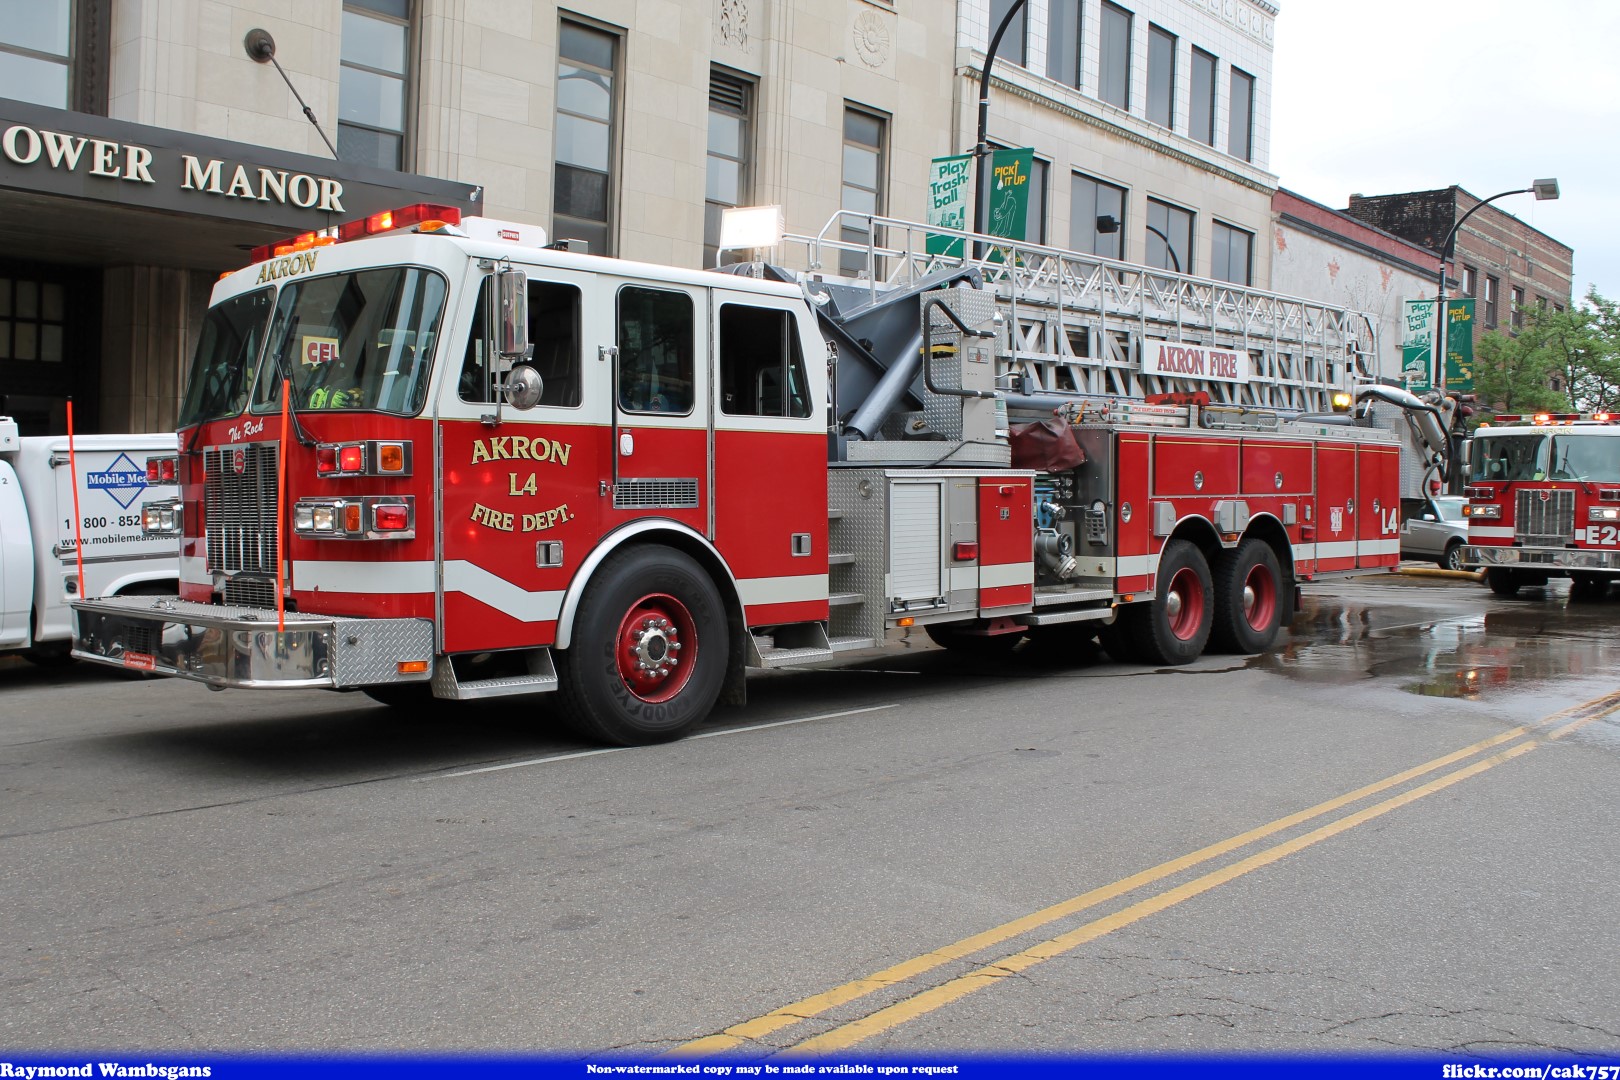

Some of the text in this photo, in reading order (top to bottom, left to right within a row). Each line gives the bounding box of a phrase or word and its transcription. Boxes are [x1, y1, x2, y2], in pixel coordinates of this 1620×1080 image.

[938, 160, 969, 179] Play
[994, 164, 1015, 178] PICK
[180, 154, 346, 213] MANOR
[1004, 174, 1027, 187] IT UP
[933, 188, 958, 209] ball
[256, 250, 319, 285] AKRON
[1411, 303, 1432, 313] Play
[1409, 320, 1427, 332] ball
[307, 341, 339, 363] CEL
[1157, 344, 1238, 379] AKRON FIRE
[228, 416, 264, 444] The Rock
[471, 435, 572, 466] AKRON
[1, 477, 9, 485] 2
[88, 473, 125, 485] Mobile
[509, 472, 538, 496] L4
[84, 517, 107, 529] 800
[118, 515, 141, 527] 852
[470, 502, 575, 532] FIRE DEPT.
[1381, 507, 1398, 535] L4
